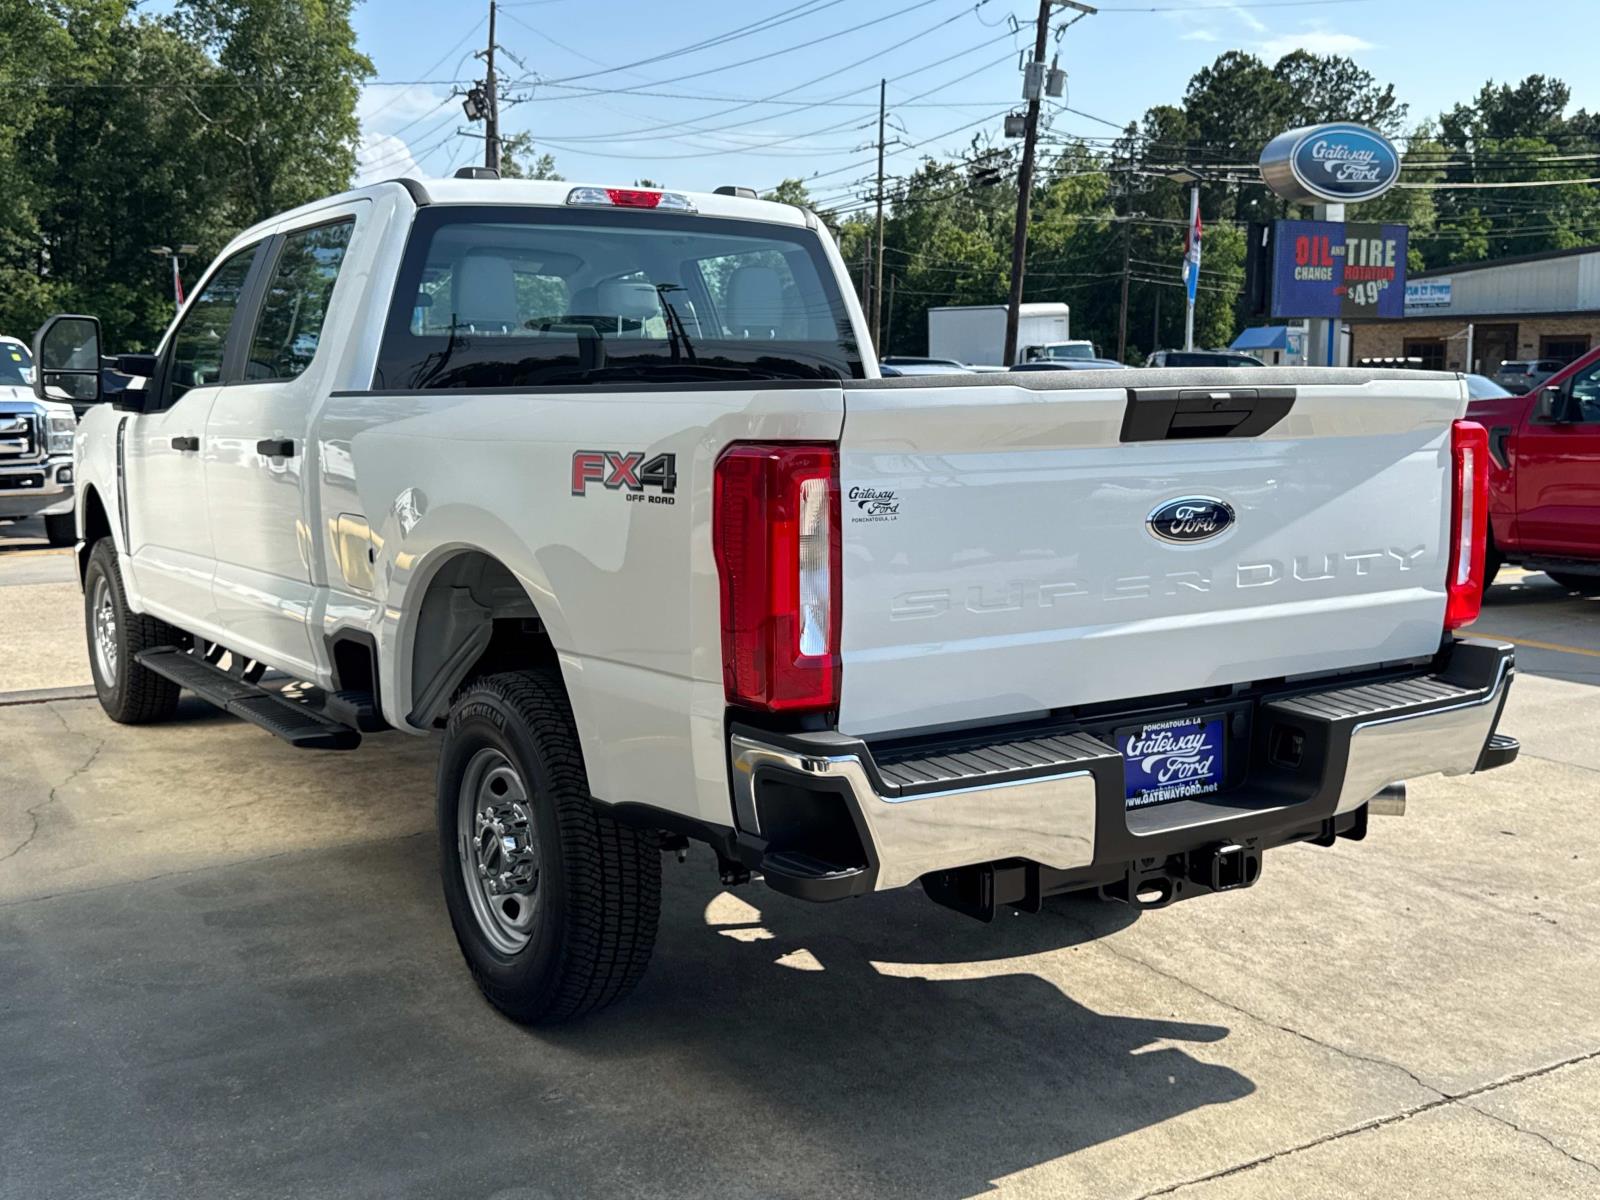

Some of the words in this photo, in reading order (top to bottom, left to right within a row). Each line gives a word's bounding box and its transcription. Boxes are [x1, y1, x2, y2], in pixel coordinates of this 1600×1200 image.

[1312, 140, 1375, 165] Gateway
[1328, 161, 1380, 181] Ford
[1296, 236, 1334, 266] OIL
[1331, 246, 1345, 256] AND
[1345, 238, 1397, 267] TIRE
[1294, 266, 1333, 281] CHANGE
[1344, 266, 1395, 281] ROTATION
[571, 449, 677, 497] FX4
[626, 494, 645, 503] OFF
[648, 495, 675, 505] ROAD
[848, 486, 896, 502] Gateway
[862, 500, 900, 515] Ford
[1170, 506, 1217, 534] Ford
[889, 570, 1213, 621] SUPER
[1236, 543, 1426, 588] DUTY
[461, 703, 504, 727] MICHELIN
[1126, 731, 1206, 757] Gateway
[1154, 754, 1214, 783] Ford
